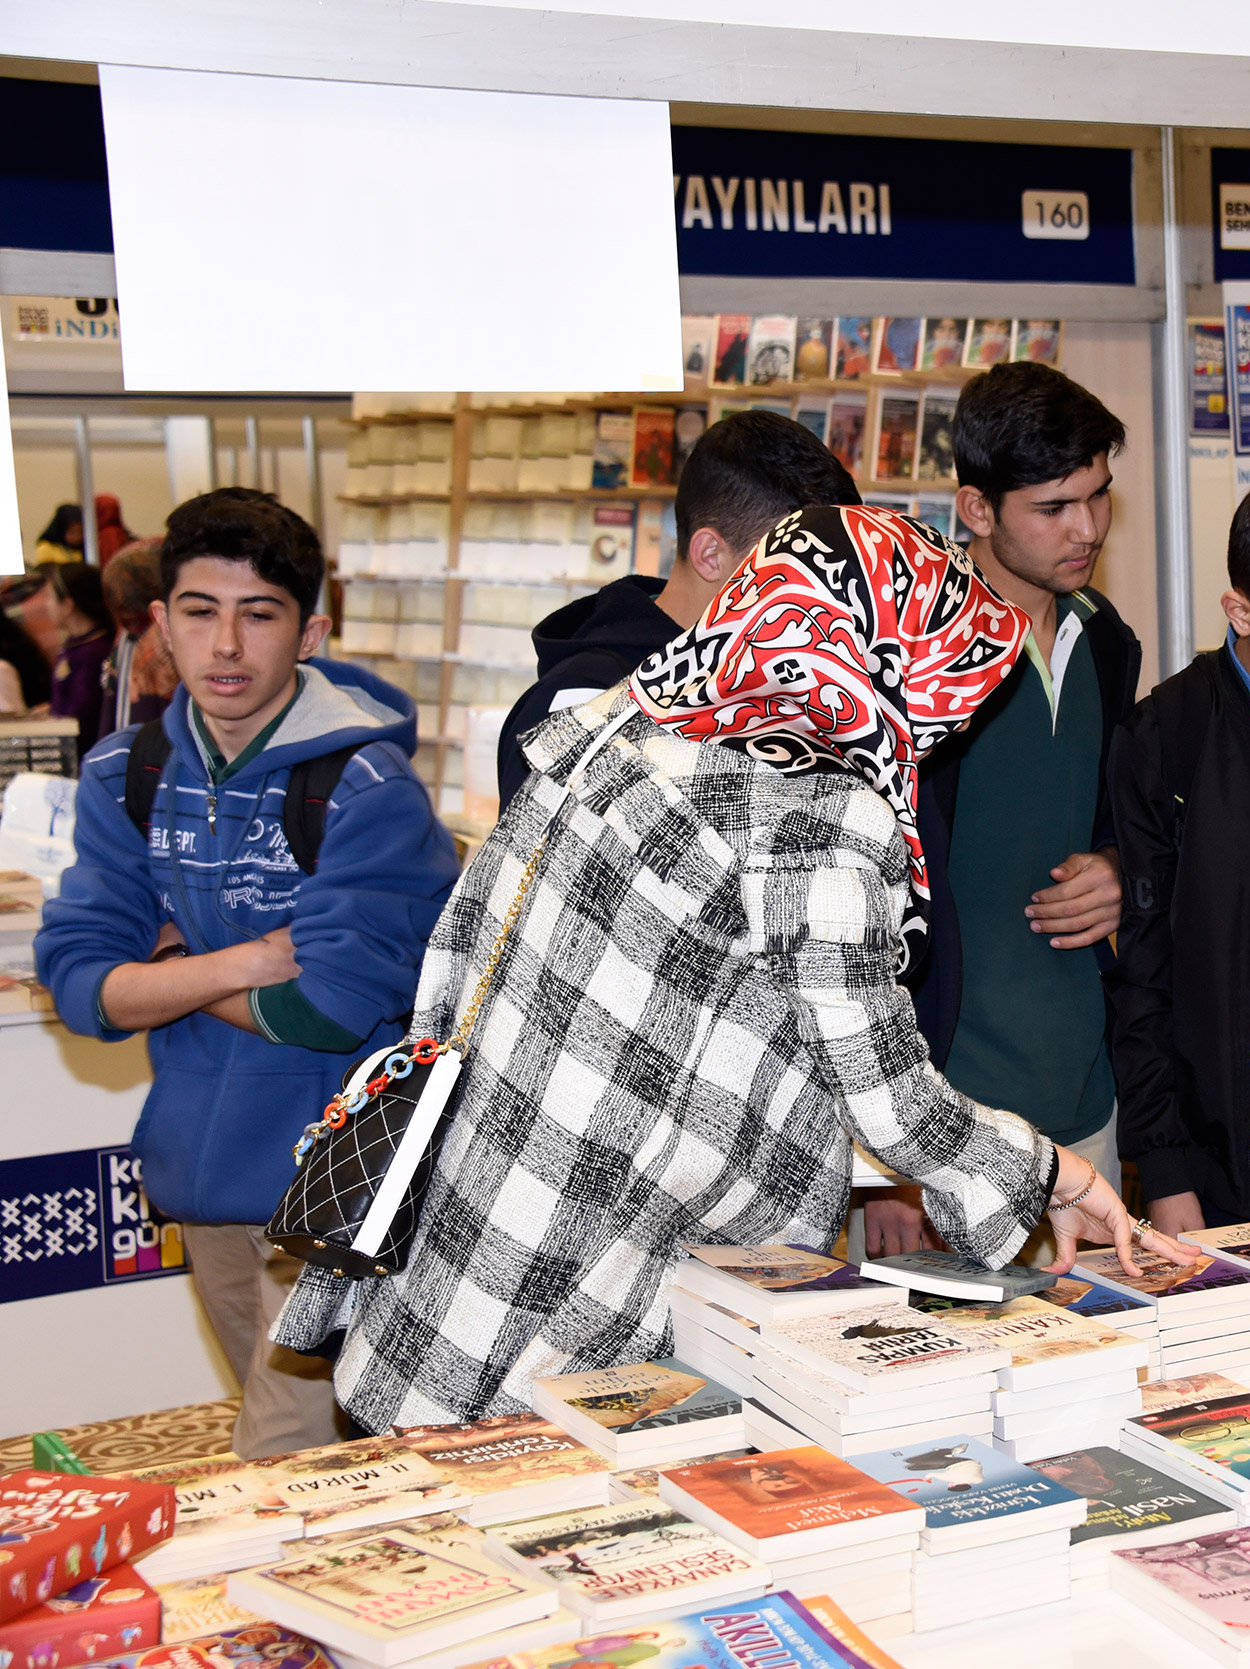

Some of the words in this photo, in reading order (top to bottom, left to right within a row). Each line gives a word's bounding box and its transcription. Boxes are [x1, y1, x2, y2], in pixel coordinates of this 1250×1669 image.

[1035, 201, 1083, 229] 160
[429, 1434, 559, 1462] Tarihimiz
[287, 1469, 380, 1494] MURAD
[991, 1481, 1052, 1500] Dostu
[785, 1505, 883, 1531] Mehmed
[1121, 1491, 1197, 1518] Nasıl
[576, 1548, 735, 1590] SESLENİYOR
[592, 1559, 752, 1601] ÇANAKKALE
